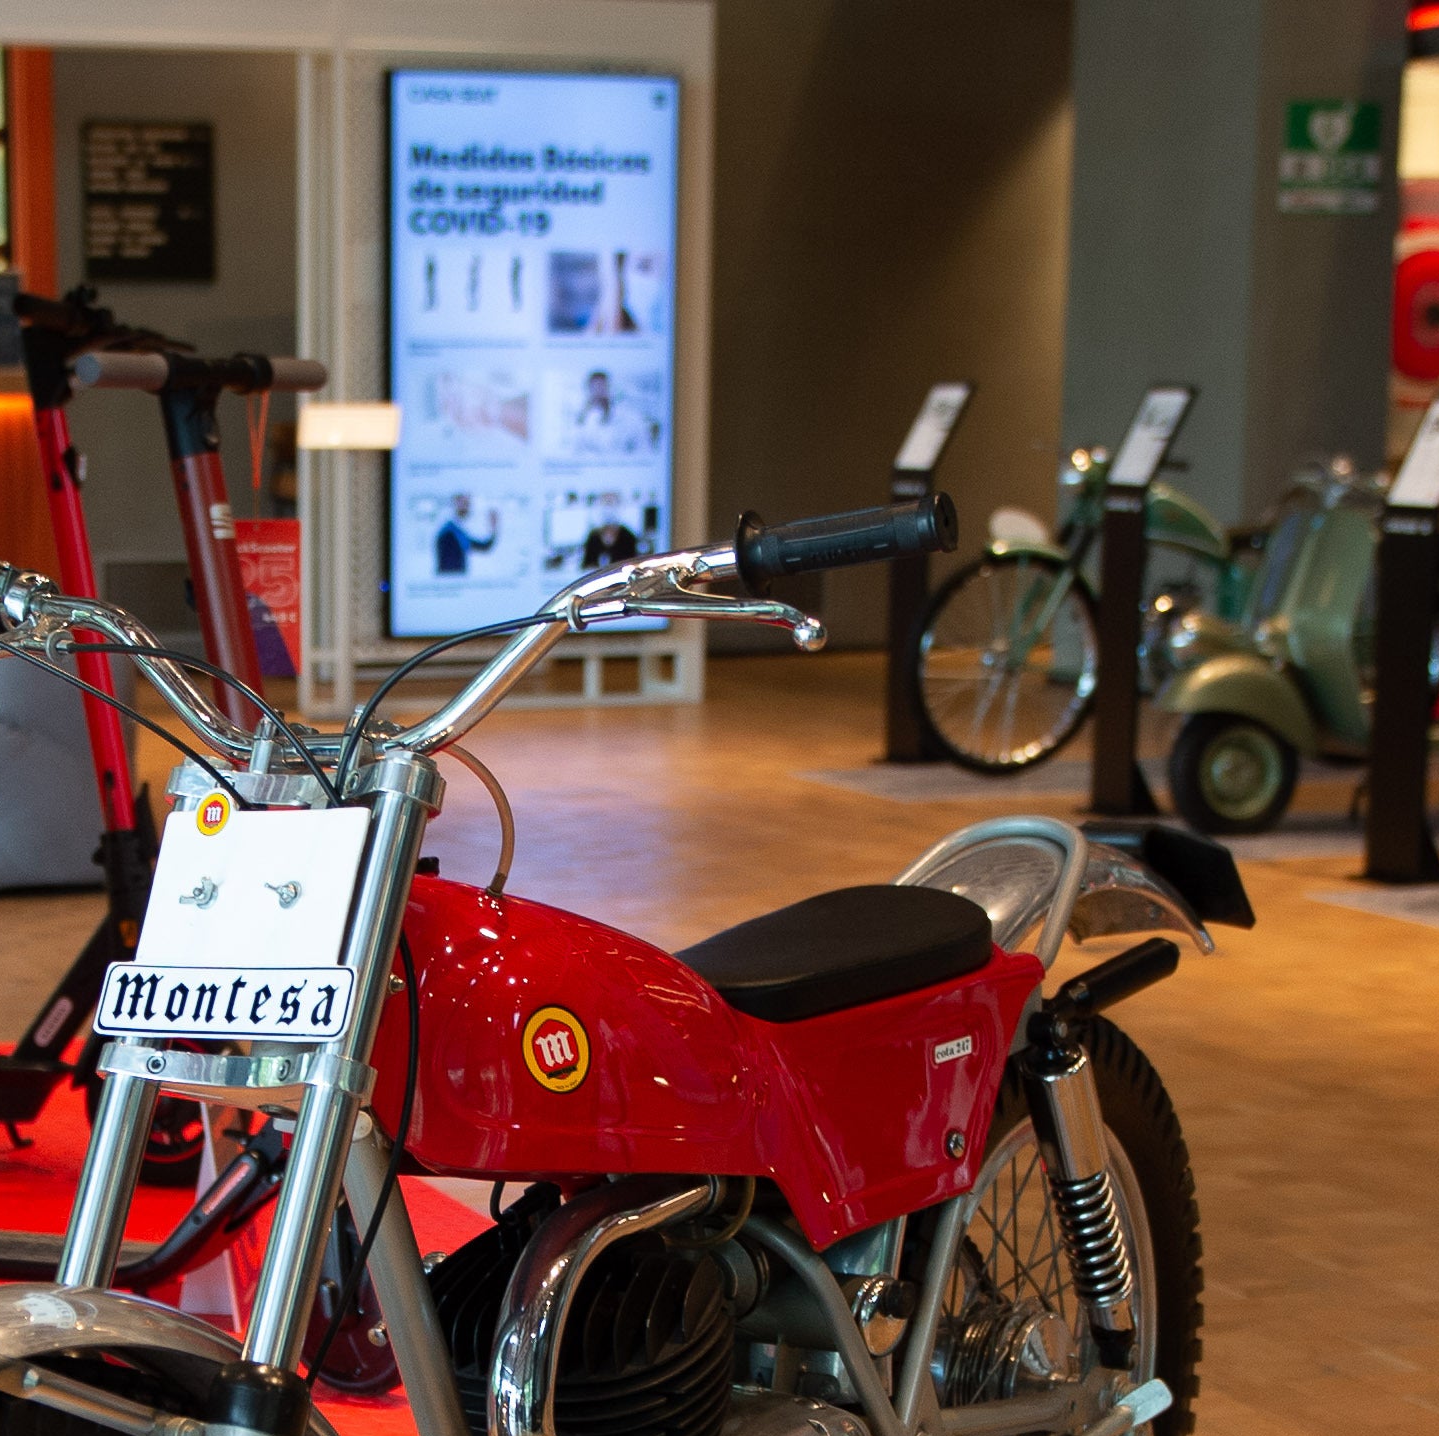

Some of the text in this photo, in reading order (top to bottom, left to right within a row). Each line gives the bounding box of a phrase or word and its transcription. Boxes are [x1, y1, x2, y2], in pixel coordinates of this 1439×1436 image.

[410, 144, 534, 171] Medidas
[409, 177, 604, 212] de seguridad
[409, 210, 552, 236] COVID-19
[111, 970, 341, 1027] Montesa
